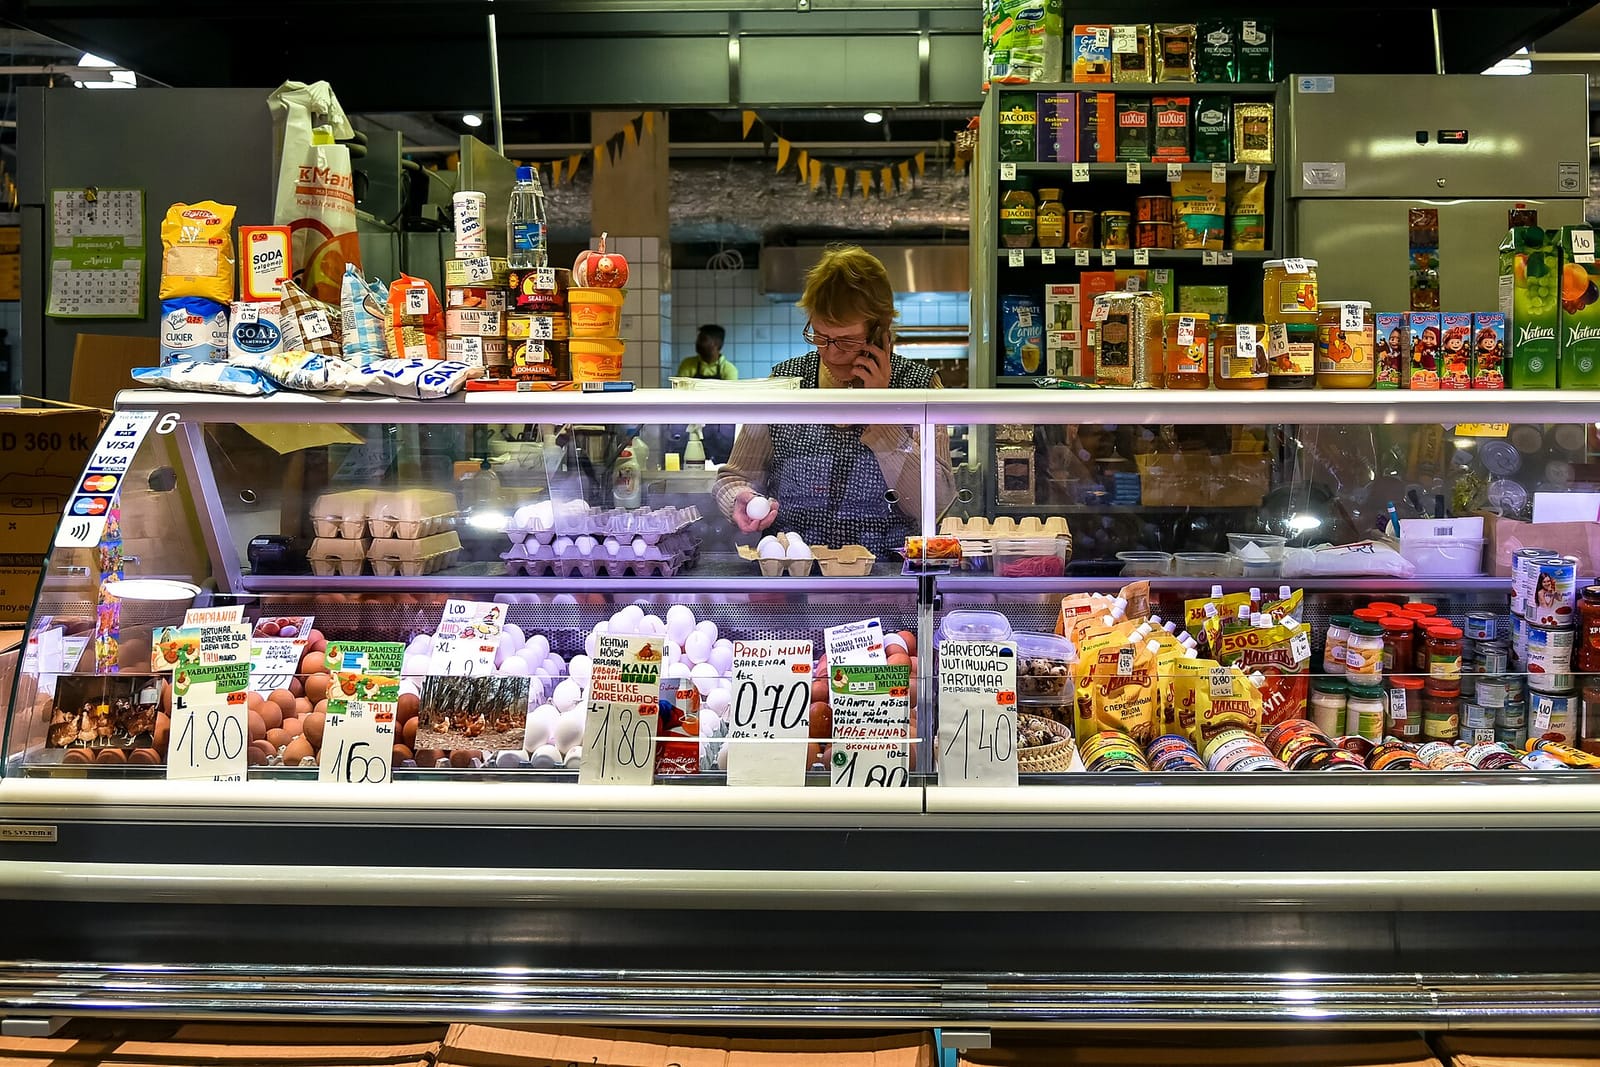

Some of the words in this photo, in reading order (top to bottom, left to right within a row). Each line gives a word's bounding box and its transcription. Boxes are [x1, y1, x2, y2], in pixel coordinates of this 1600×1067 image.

[1000, 113, 1035, 122] JACOBS
[1121, 114, 1144, 124] LUXUS
[1160, 114, 1184, 124] LUXUS
[253, 249, 283, 265] SODA
[166, 333, 193, 342] CUKIER
[237, 328, 279, 339] СОЛЬ
[1516, 322, 1555, 345] Natura
[156, 413, 180, 435] 6
[24, 433, 62, 451] 360
[68, 432, 89, 451] tk
[106, 441, 135, 449] VISA
[98, 456, 127, 465] VISA
[187, 611, 237, 624] KAMPAANIA
[1224, 633, 1258, 650] 500
[339, 645, 403, 653] VABAPIDAMISEL
[777, 644, 811, 655] MUNA
[941, 641, 999, 657] JÄRVEOTSA
[367, 653, 402, 661] KANADE
[371, 660, 401, 668] MUNAD
[941, 659, 1008, 672] VUTIMUNAD
[187, 663, 249, 676] VABAPIDAMISEL
[622, 664, 659, 675] KANA
[843, 666, 908, 674] VABAPIDAMISEL
[215, 672, 248, 681] KANADE
[940, 672, 1003, 687] TARTUMAA
[218, 679, 247, 687] MUNAD
[878, 680, 909, 688] MUNAD
[592, 691, 659, 704] ÕRREKANADE
[833, 696, 846, 705] OÜ
[367, 703, 392, 713] TALU
[735, 681, 810, 729] 0.70
[868, 728, 907, 737] MUNAD
[177, 711, 243, 767] 1.80
